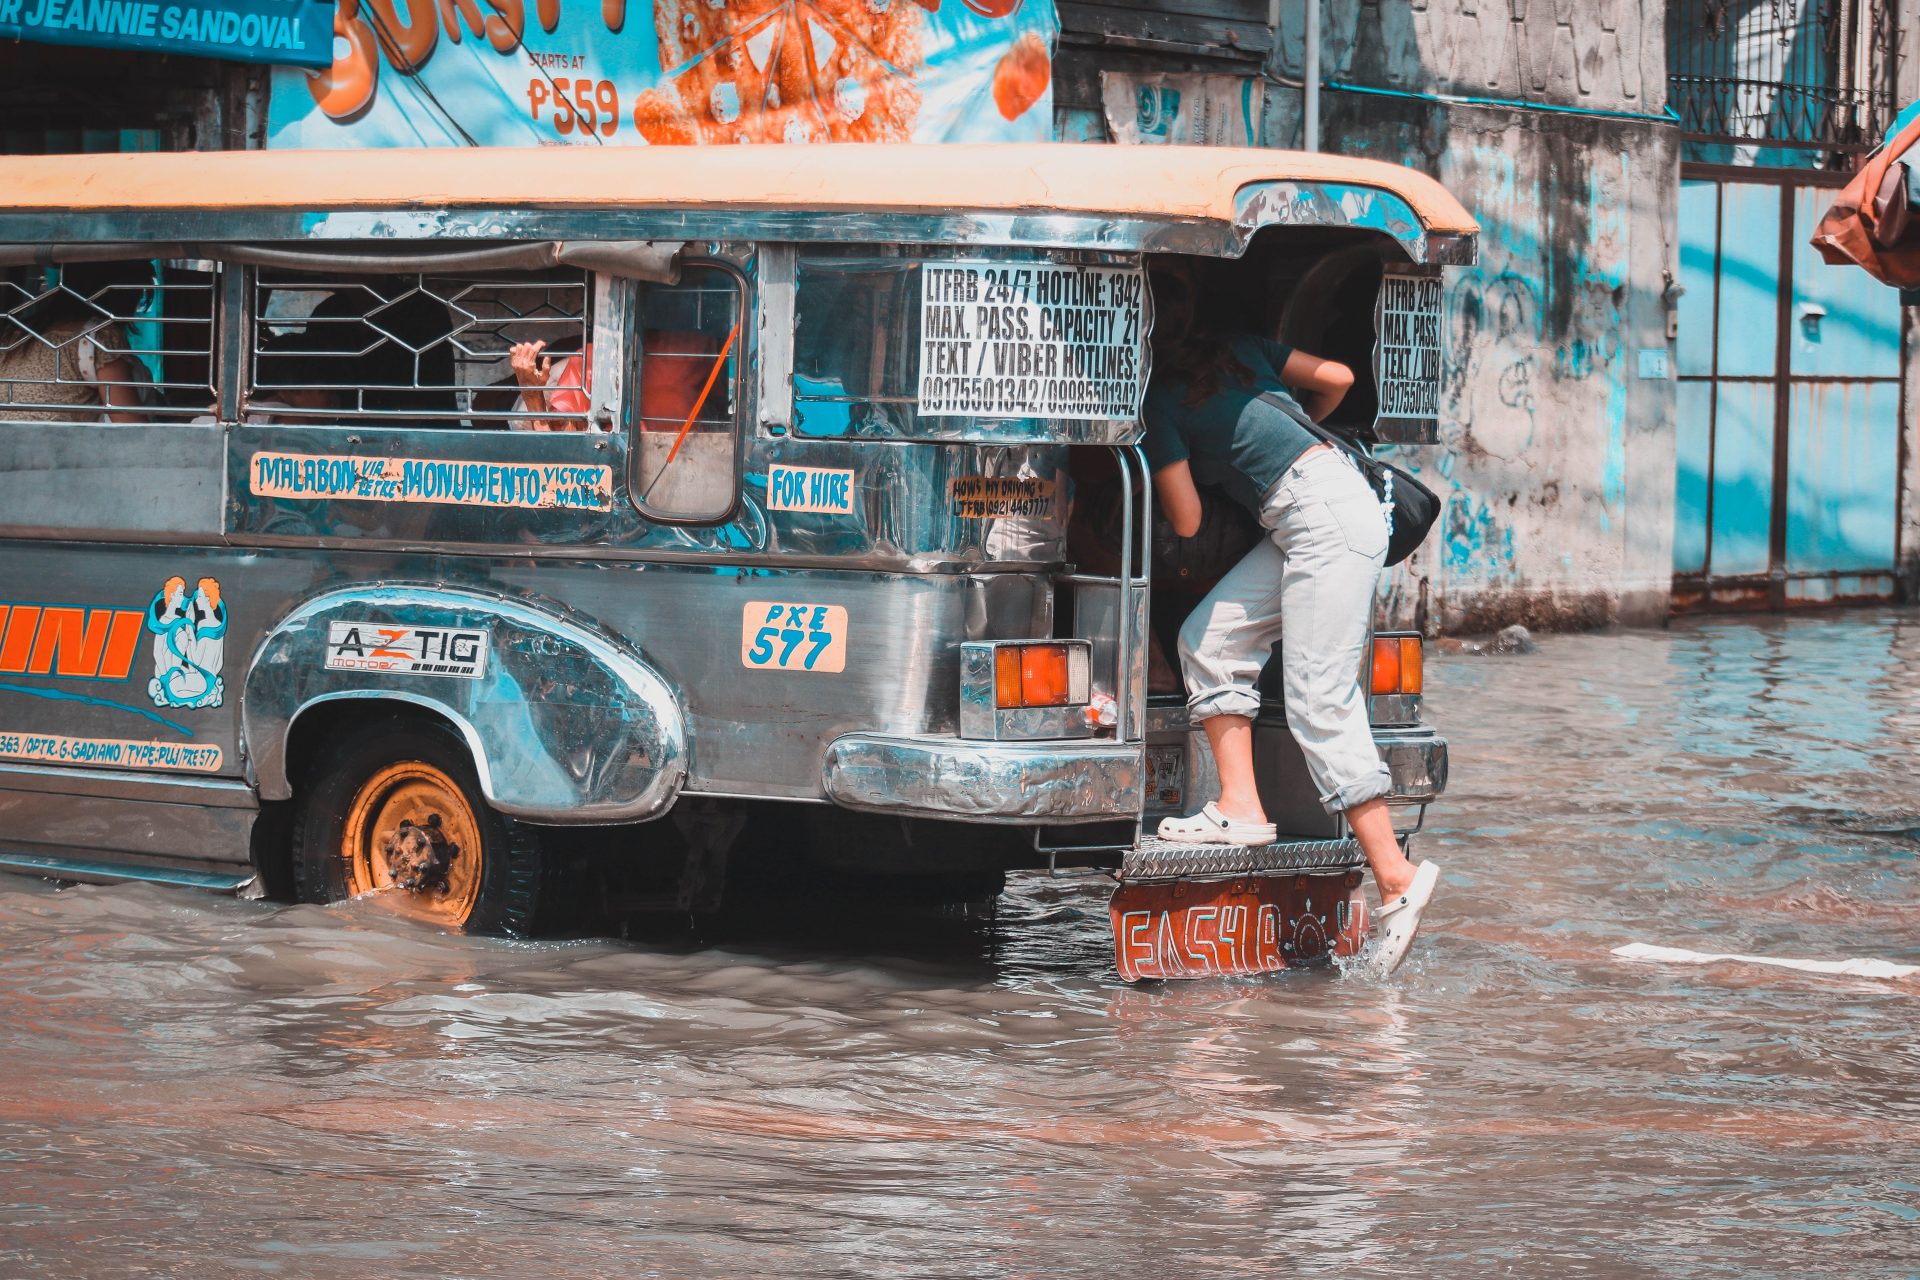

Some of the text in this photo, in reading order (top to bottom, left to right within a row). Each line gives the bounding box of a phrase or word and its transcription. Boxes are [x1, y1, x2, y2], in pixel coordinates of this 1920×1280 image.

[25, 0, 159, 37] JEANNIE
[161, 7, 306, 49] SANDOVAL
[529, 53, 585, 70] STARTS AT
[926, 269, 1141, 309] LTFRB 24/7 HOTLINE: 1342
[1384, 278, 1415, 312] LTFRB
[926, 305, 1139, 345] MAX. PASS. CAPACITY 21
[1383, 313, 1438, 348] MAX. PASS.
[925, 341, 1137, 380] TEXT / VIBER HOTLINES:
[1383, 347, 1411, 380] TEXT
[1413, 347, 1419, 381] /
[259, 457, 355, 494] MALABON
[362, 460, 385, 477] VIA
[543, 466, 605, 486] VICTORY
[555, 486, 600, 507] MALL
[772, 469, 850, 510] FOR HIRE
[985, 480, 998, 498] MY
[1002, 480, 1036, 497] DRIVING
[765, 604, 829, 630] PXE
[336, 627, 481, 663] AZTIG
[748, 626, 832, 670] 577
